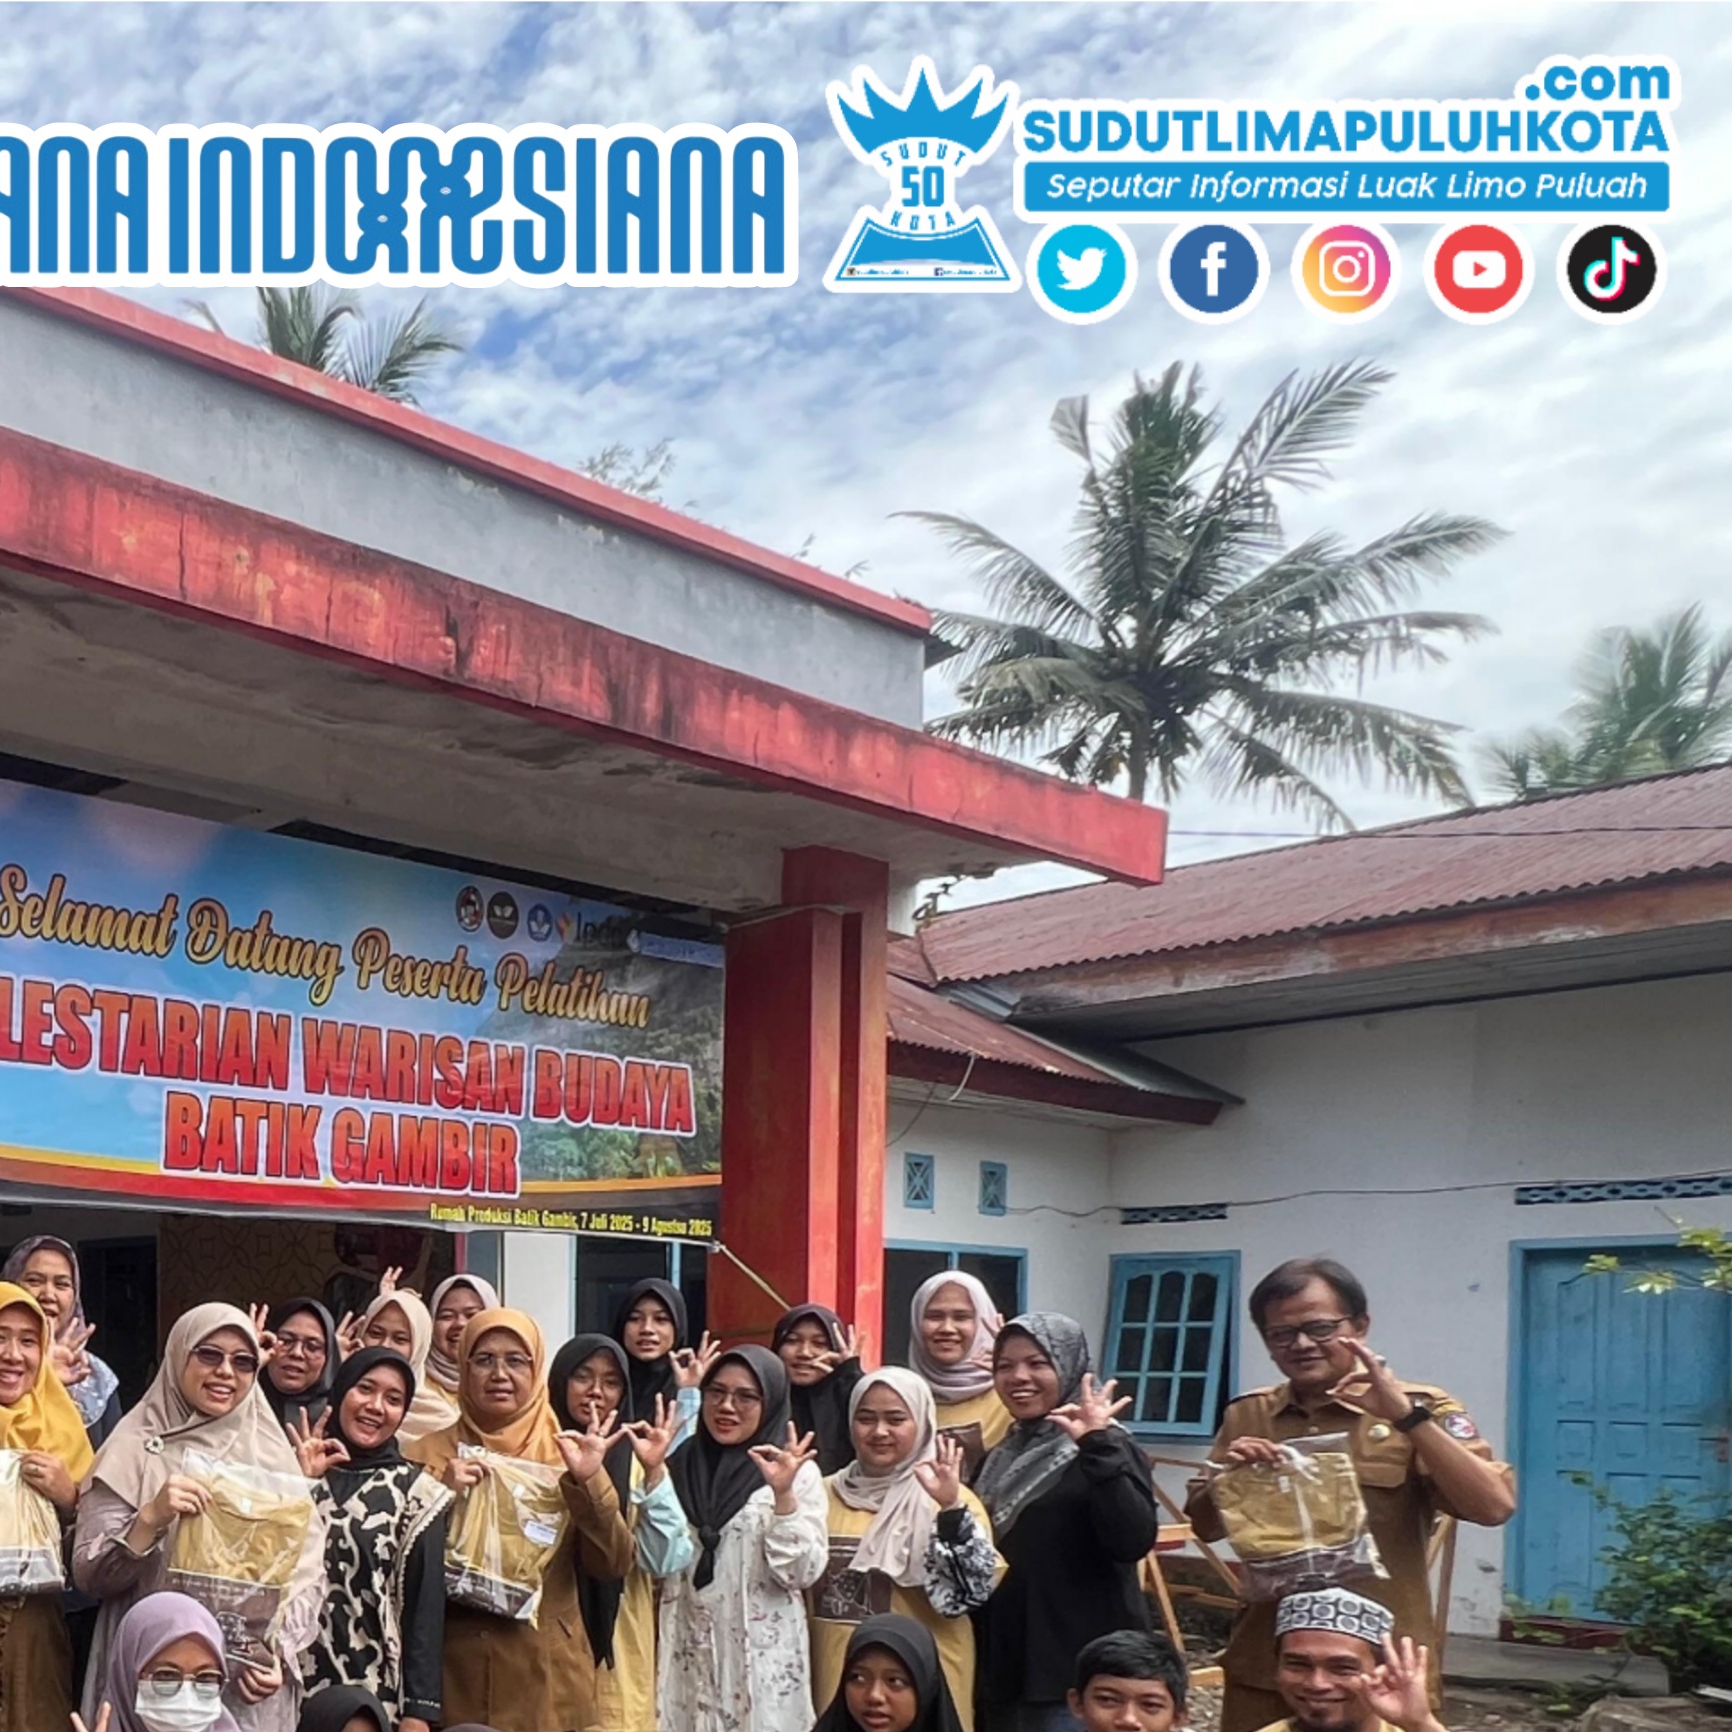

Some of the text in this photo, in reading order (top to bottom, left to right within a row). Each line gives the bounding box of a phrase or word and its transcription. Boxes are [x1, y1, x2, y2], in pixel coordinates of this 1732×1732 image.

[185, 898, 344, 1006] Datang
[352, 927, 486, 1005] Peserta
[494, 952, 651, 1029] Pelatihan
[301, 1017, 525, 1116] WARISAN
[532, 1048, 695, 1132] BUDAYA
[164, 1090, 518, 1195] BATIK GAMBIR
[468, 1205, 512, 1225] Produksi
[580, 1212, 588, 1229] 7
[589, 1213, 608, 1230] Juli
[609, 1214, 633, 1232] 2025
[642, 1216, 650, 1233] 9
